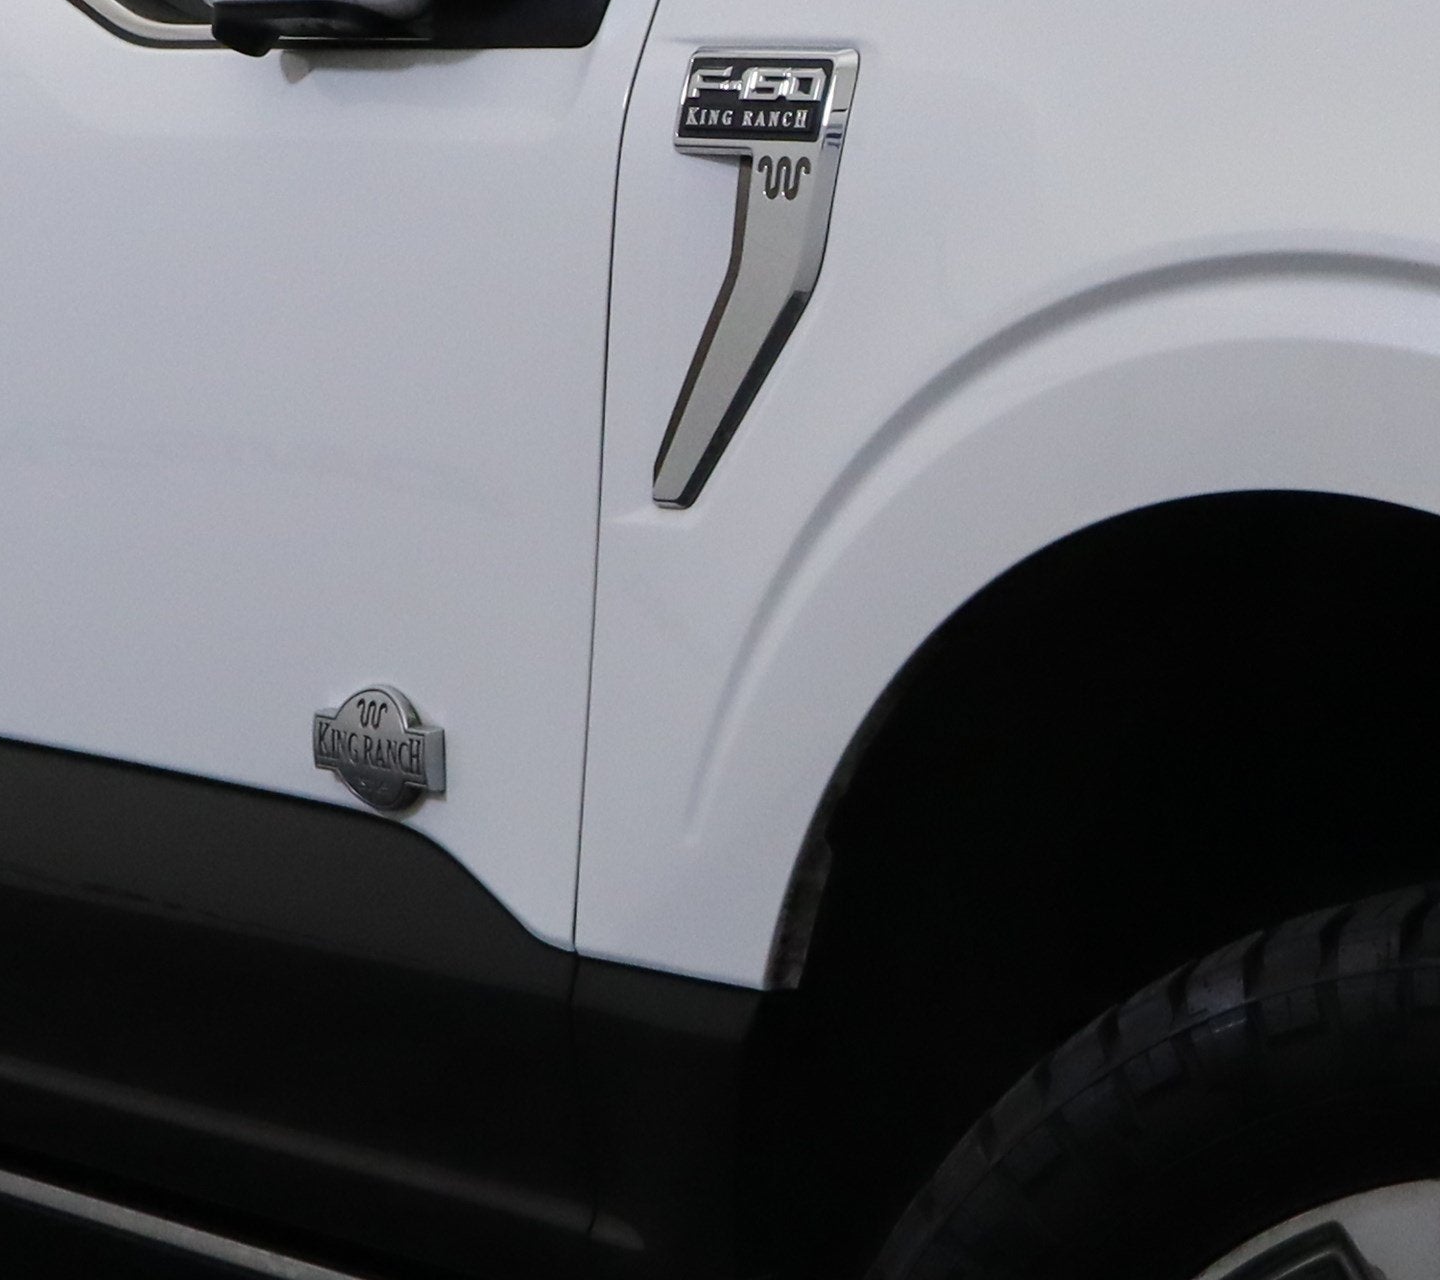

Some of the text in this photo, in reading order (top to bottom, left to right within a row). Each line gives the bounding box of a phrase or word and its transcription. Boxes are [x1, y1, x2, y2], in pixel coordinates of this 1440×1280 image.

[688, 66, 827, 102] F-150
[685, 107, 810, 129] KING RANCH
[318, 721, 423, 777] KING RANCH
